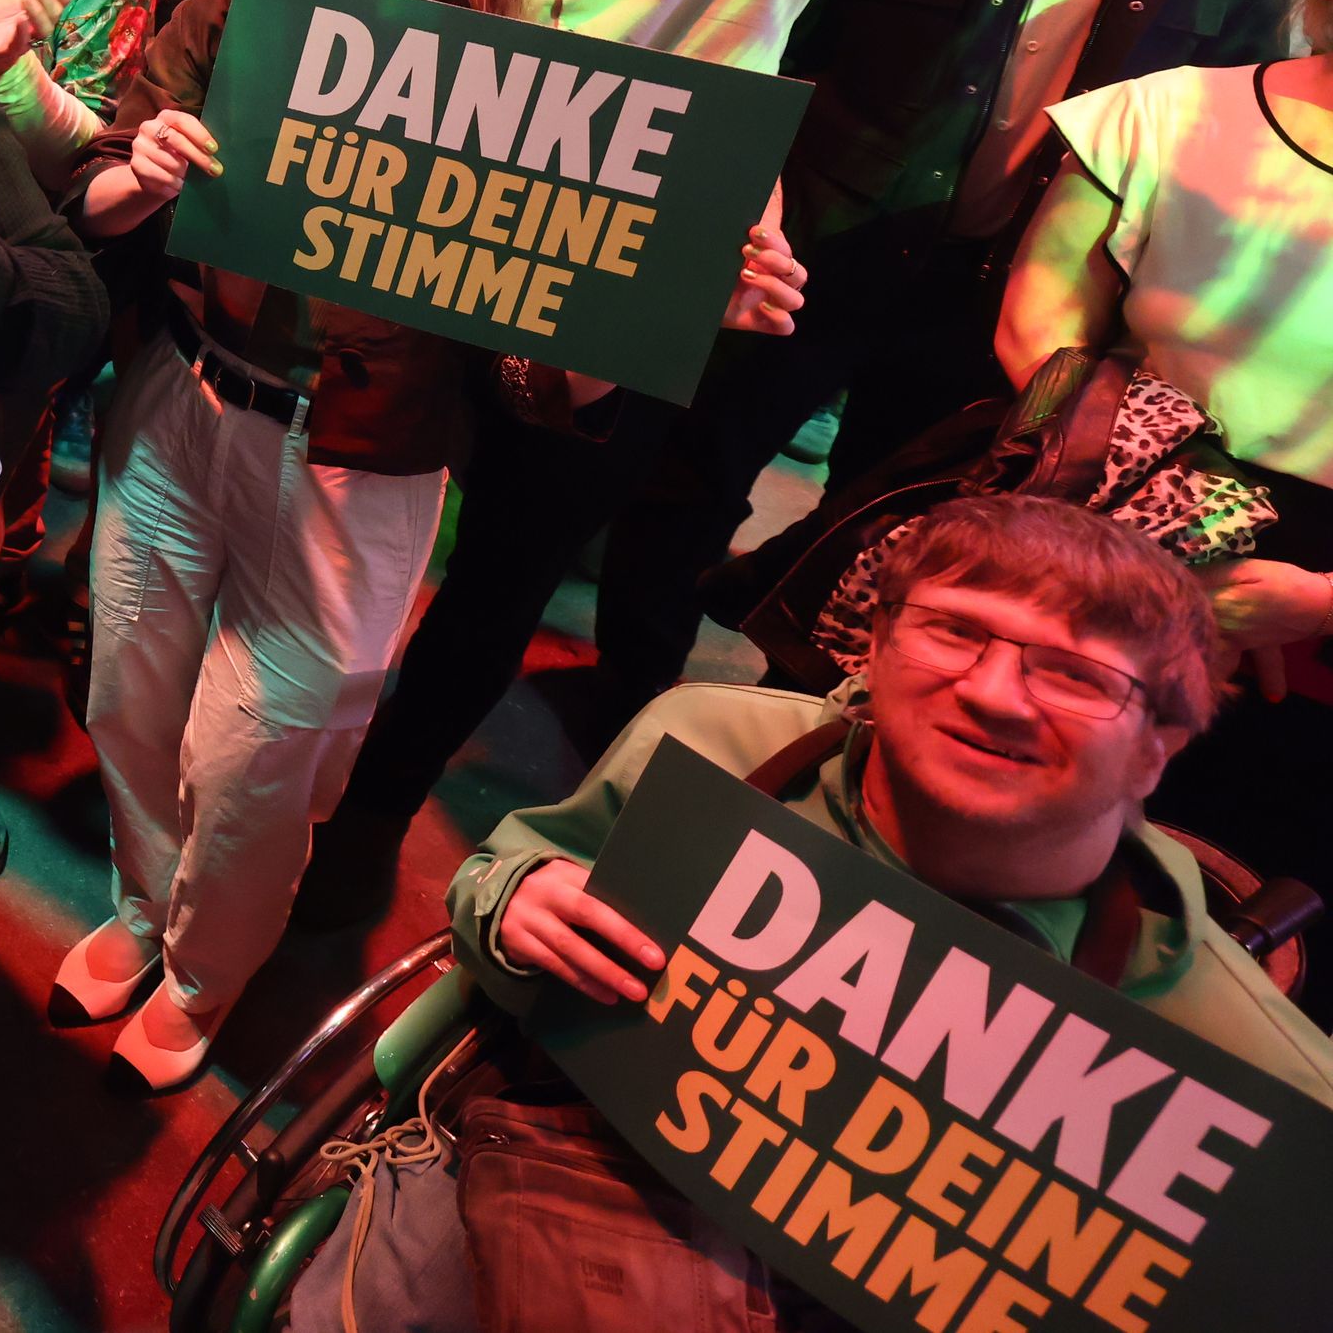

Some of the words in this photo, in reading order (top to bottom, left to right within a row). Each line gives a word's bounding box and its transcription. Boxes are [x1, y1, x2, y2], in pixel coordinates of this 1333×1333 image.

[266, 117, 408, 216] FÜR
[416, 155, 657, 278] DEINE
[287, 6, 693, 199] DANKE
[292, 205, 575, 337] STIMME
[687, 828, 1273, 1245] DANKE
[645, 943, 836, 1127] FÜR
[832, 1075, 1191, 1333] DEINE
